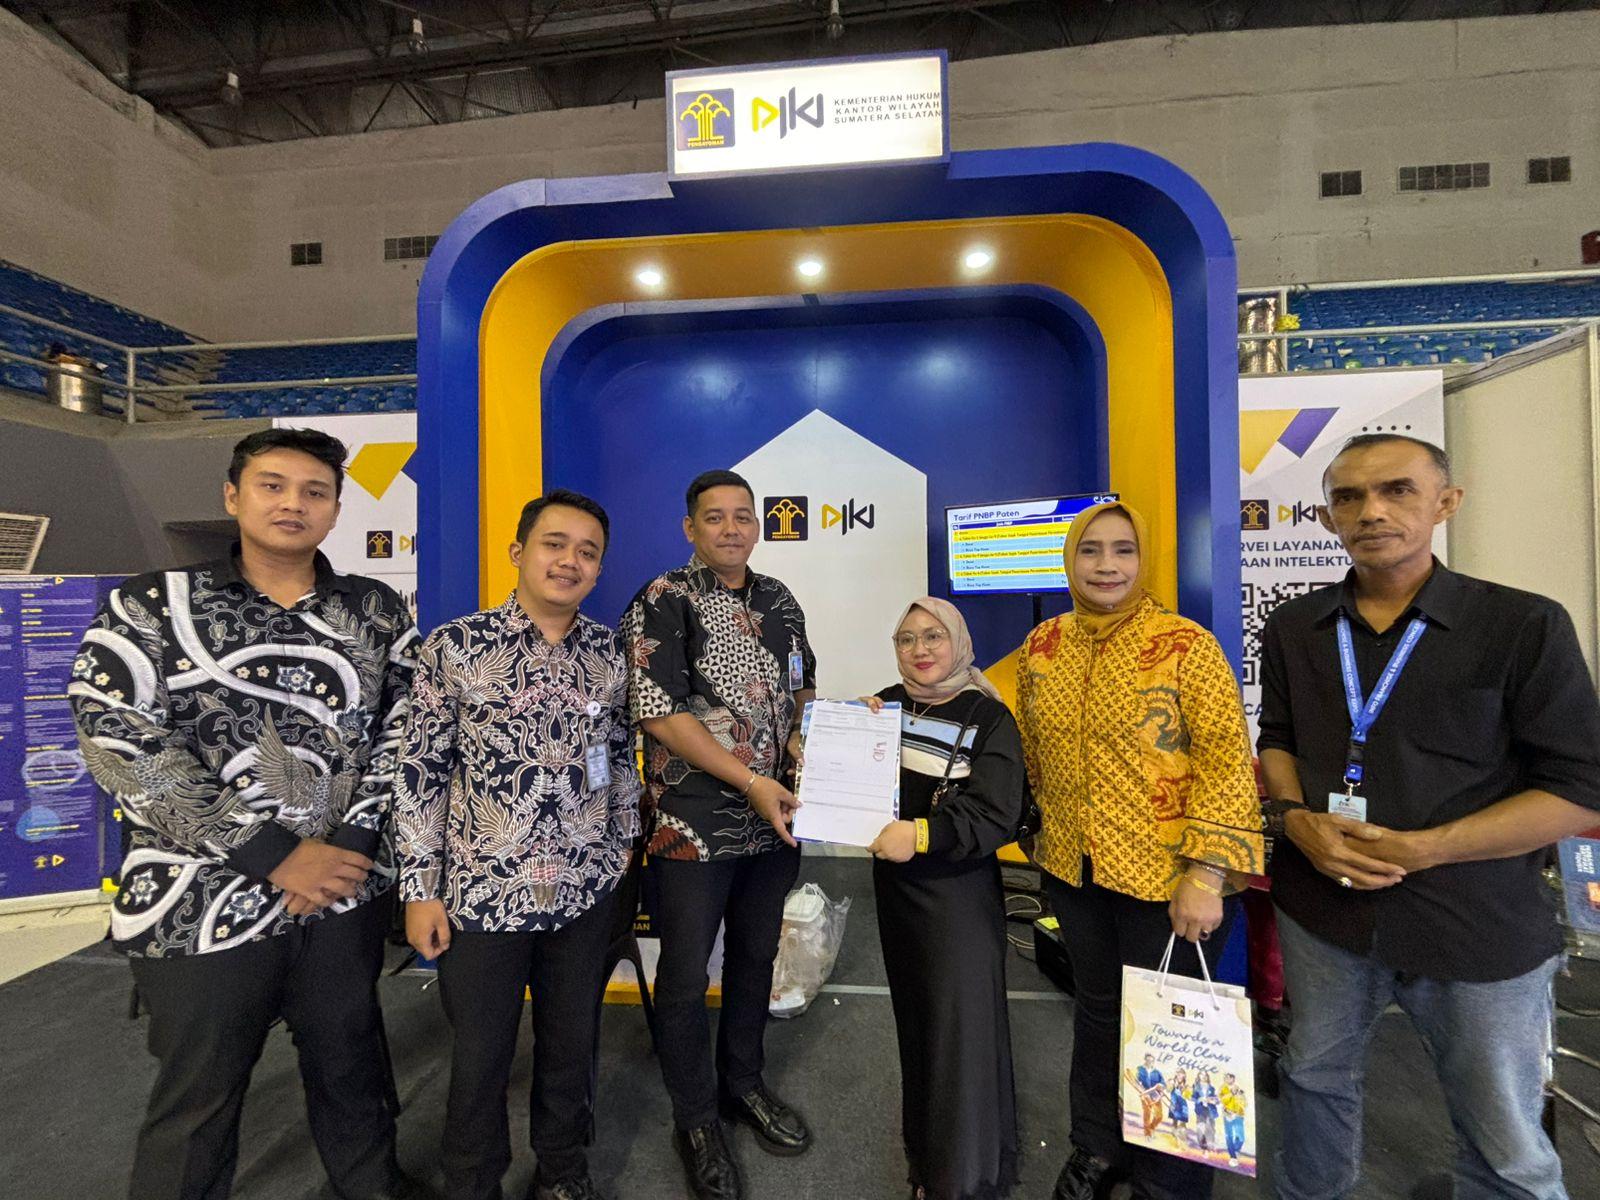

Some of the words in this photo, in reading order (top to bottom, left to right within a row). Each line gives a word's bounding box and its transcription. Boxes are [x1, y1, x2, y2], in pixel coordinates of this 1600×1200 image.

[834, 94, 902, 106] KEMENTERIAN
[906, 92, 940, 101] HUKUM
[836, 105, 882, 115] KANTOR
[888, 101, 939, 111] WILAYAH
[834, 113, 890, 124] SUMATERA
[895, 110, 941, 120] SELATAN
[953, 513, 972, 522] Tarif
[973, 511, 995, 520] PNBP
[996, 510, 1020, 519] Paten
[1273, 540, 1344, 552] LAYANAN
[1275, 556, 1354, 568] INTELEKTU
[1152, 1023, 1208, 1044] Towards
[1144, 1034, 1191, 1054] World
[1193, 1046, 1232, 1062] Class
[1177, 1055, 1219, 1074] Office
